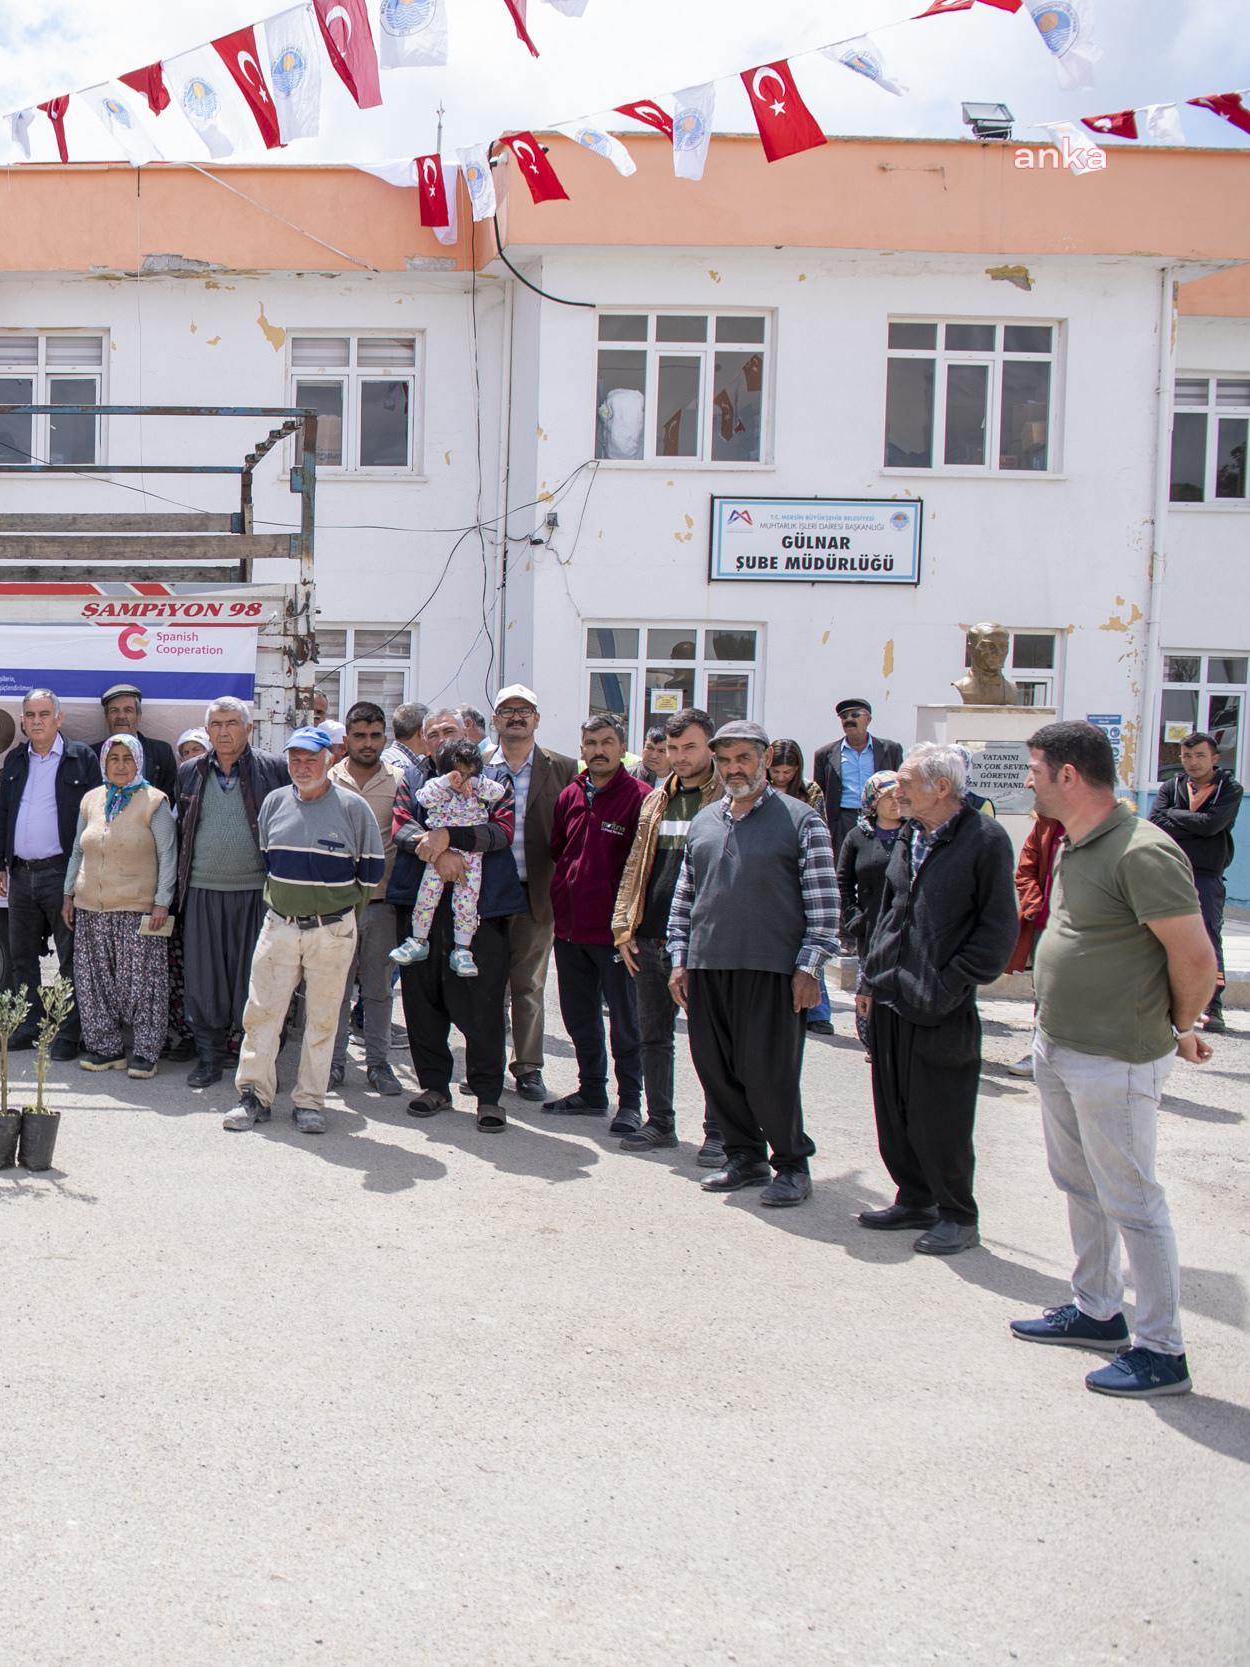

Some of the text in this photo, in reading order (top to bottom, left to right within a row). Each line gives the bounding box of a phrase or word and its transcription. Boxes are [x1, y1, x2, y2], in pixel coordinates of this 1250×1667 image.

[805, 513, 842, 522] BÜYÜKŞEHİR
[759, 522, 885, 531] MUHTARLIK İŞLERİ DAİRESİ BAŞKANLIĞI
[781, 532, 851, 550] GÜLNAR
[735, 553, 894, 572] ŞUBE MÜDÜRLÜĞÜ
[227, 602, 262, 617] 98
[156, 632, 199, 643] Spanish
[156, 645, 223, 657] Cooperation
[984, 763, 1002, 771] ÇOK
